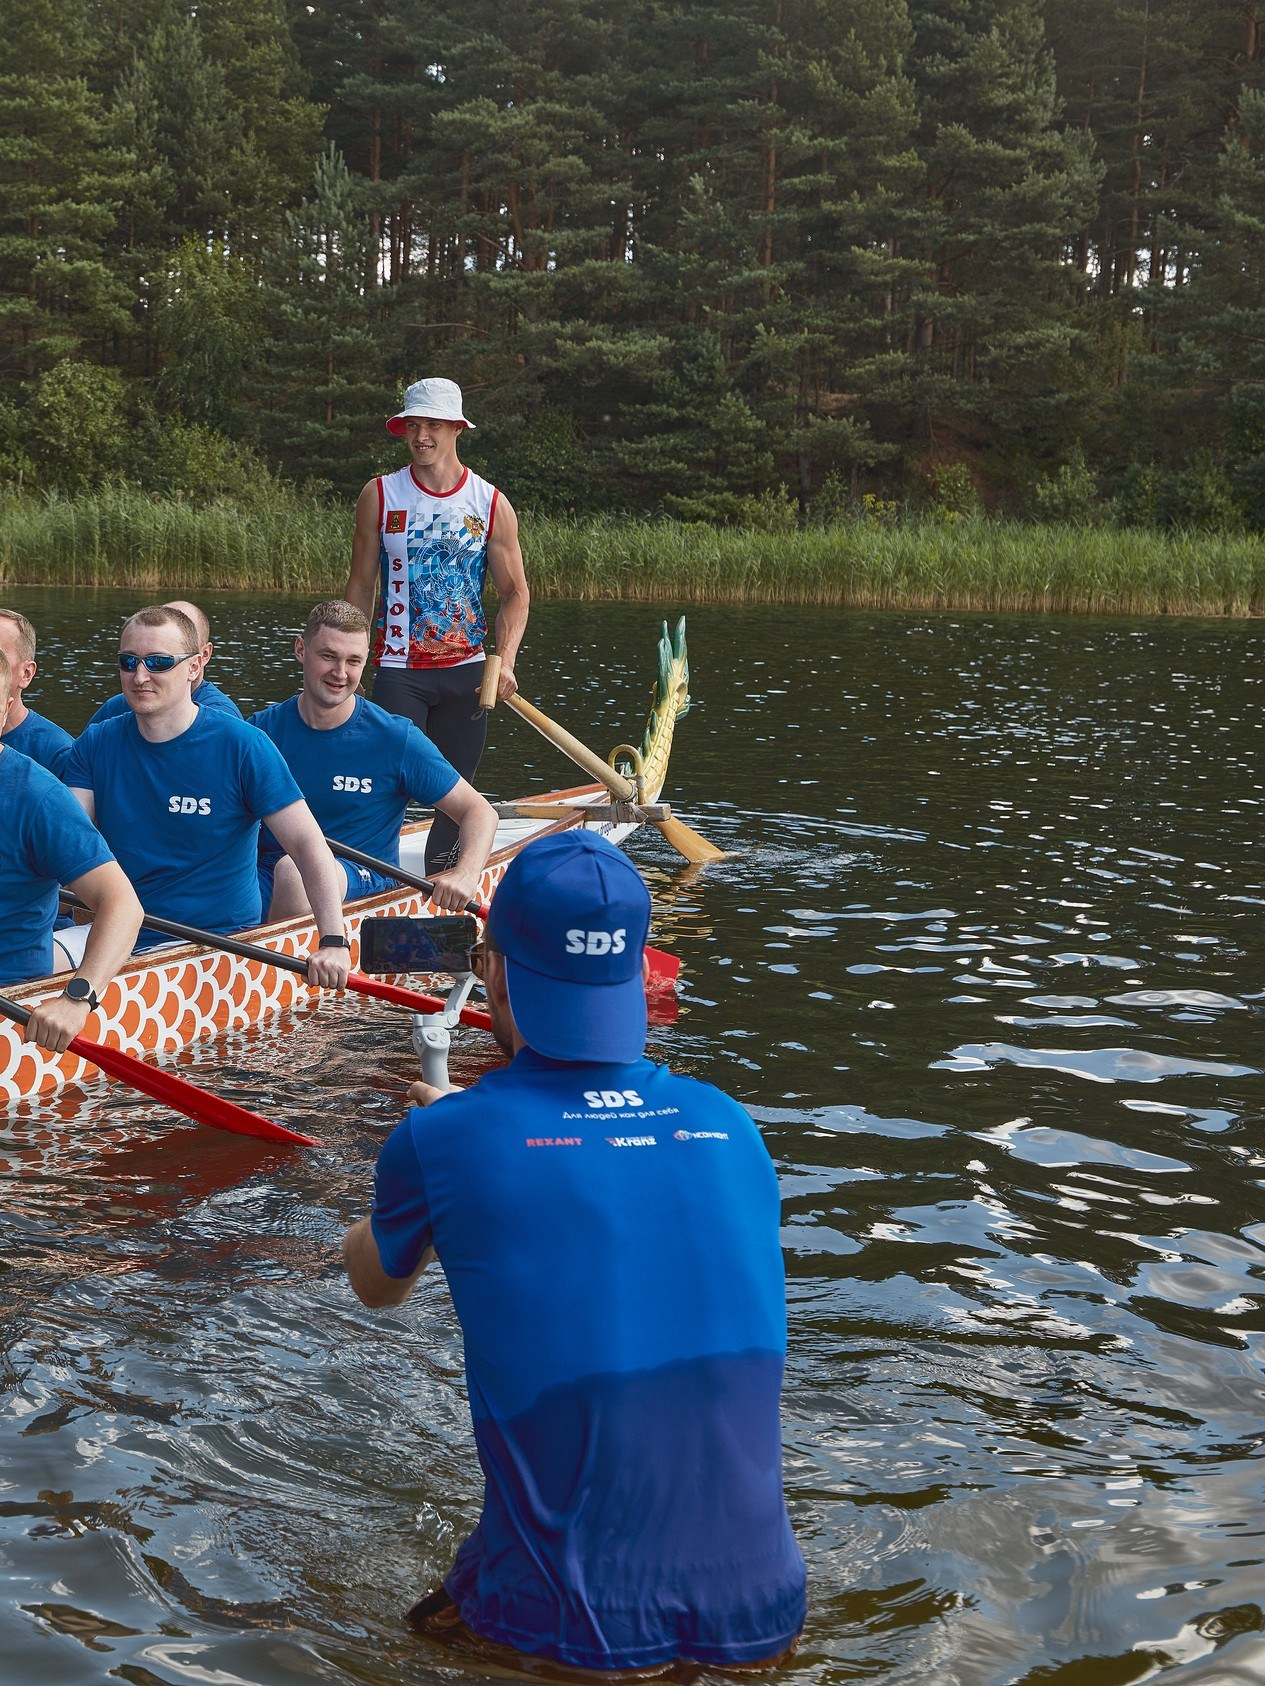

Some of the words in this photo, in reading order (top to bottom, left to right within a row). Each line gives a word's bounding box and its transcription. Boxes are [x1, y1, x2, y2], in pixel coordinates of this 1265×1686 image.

[385, 558, 406, 656] STORM
[332, 775, 373, 794] SDS
[168, 795, 211, 816] SDS
[565, 928, 627, 956] SDS
[583, 1090, 644, 1108] SDS
[526, 1137, 582, 1147] REXANT
